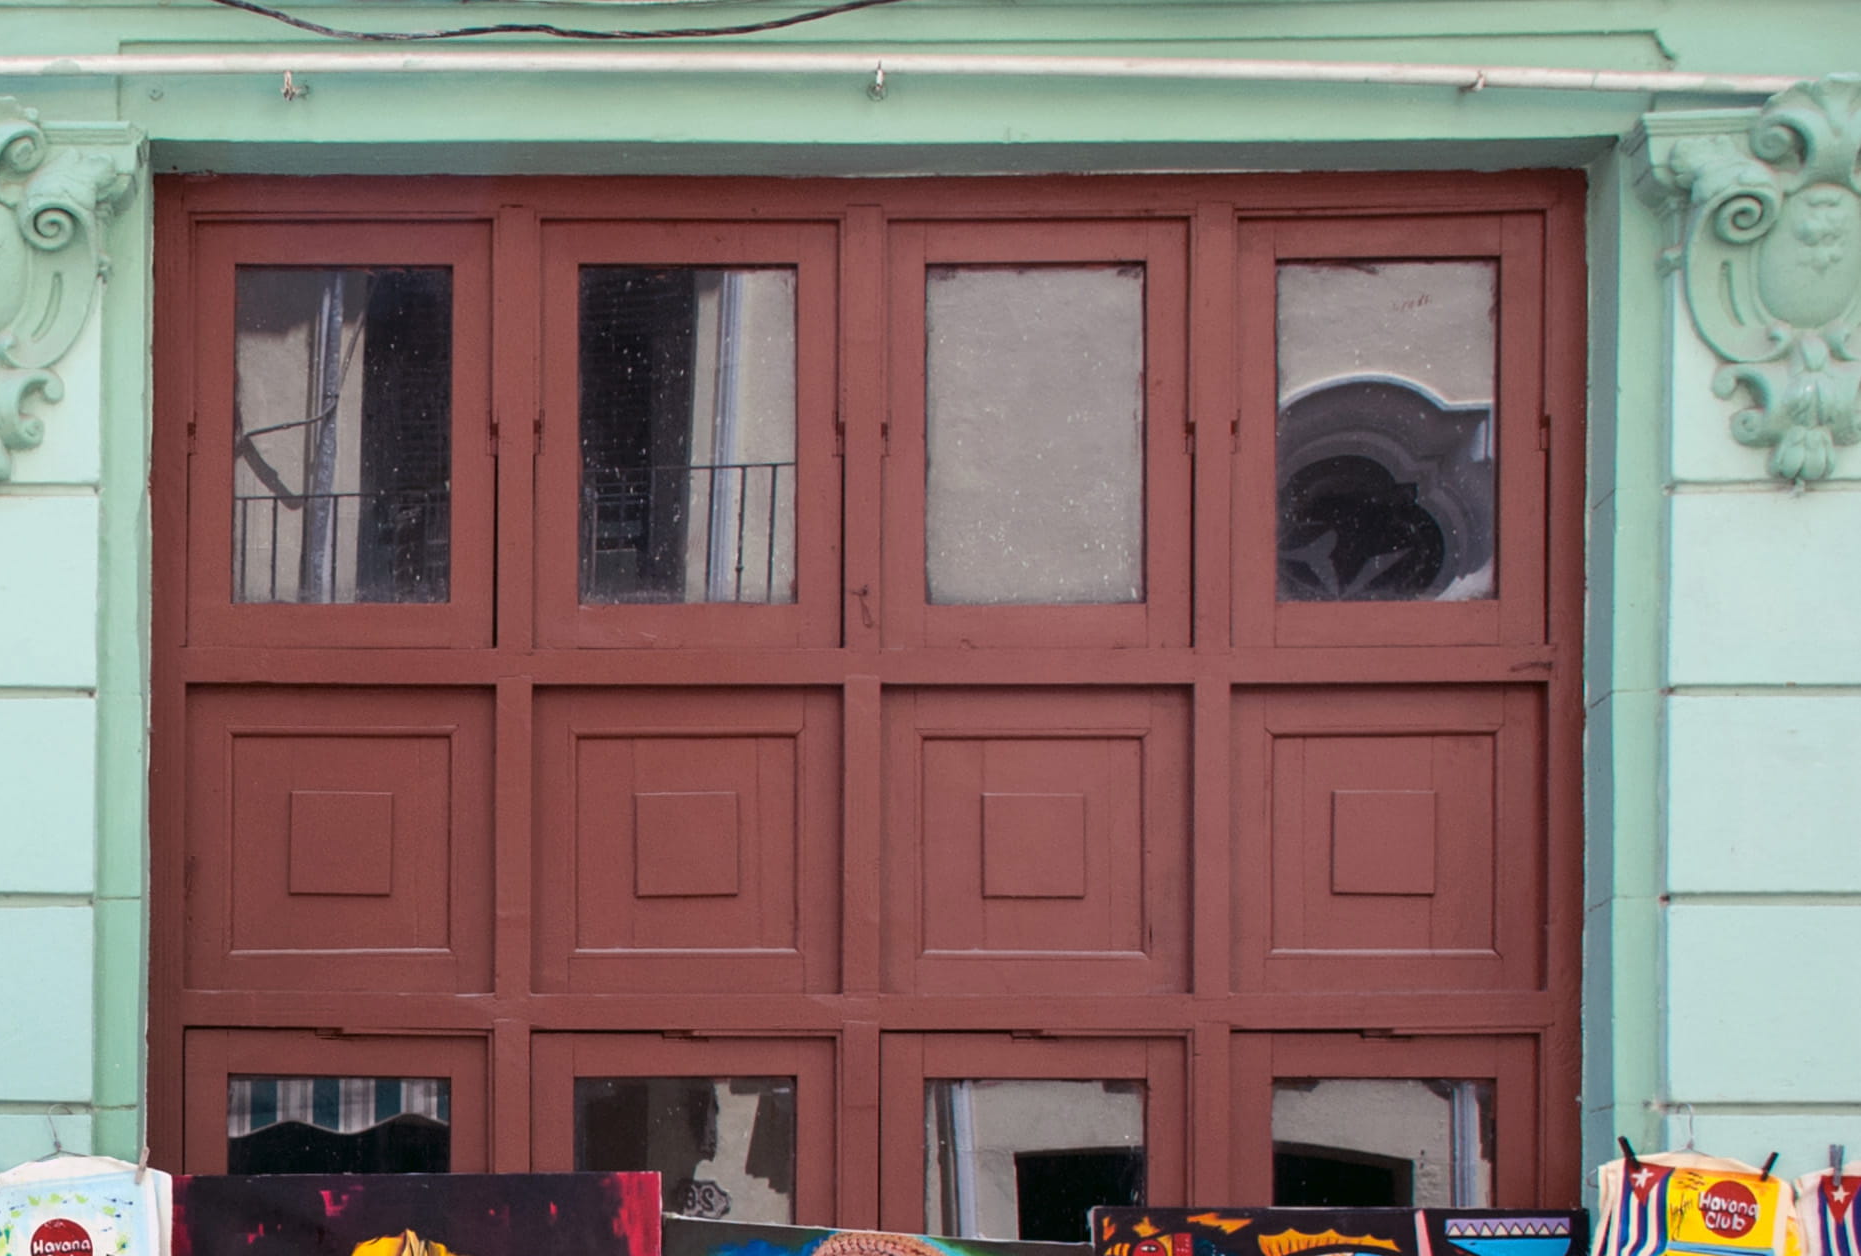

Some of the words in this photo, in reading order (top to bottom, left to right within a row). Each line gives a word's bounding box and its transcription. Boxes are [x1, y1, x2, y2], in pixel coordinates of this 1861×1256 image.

[1698, 1190, 1760, 1219] Havana
[1705, 1211, 1746, 1231] Club
[32, 1239, 91, 1256] Havana
